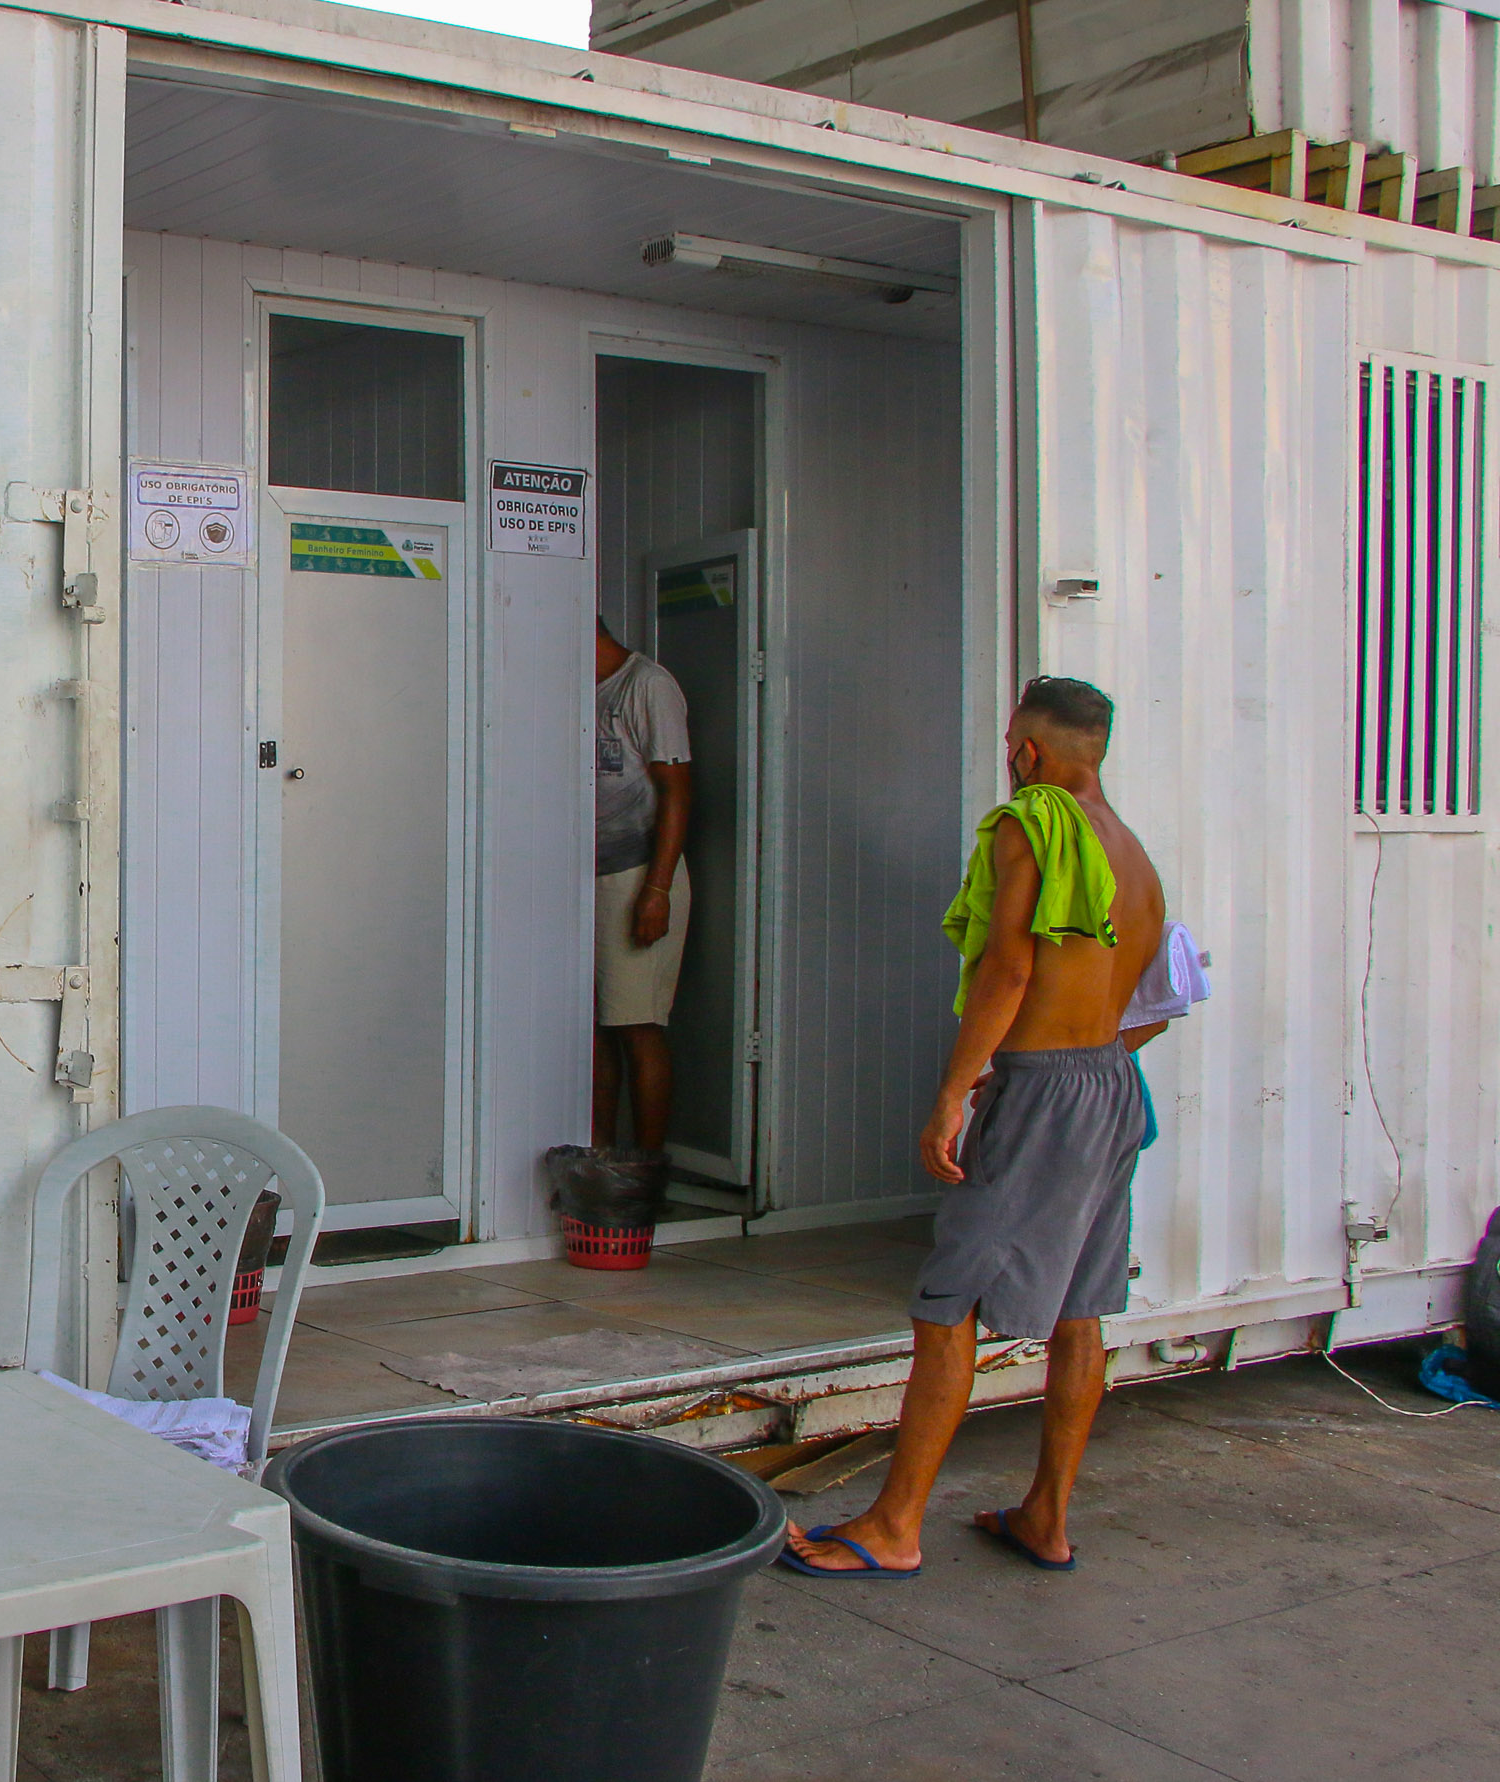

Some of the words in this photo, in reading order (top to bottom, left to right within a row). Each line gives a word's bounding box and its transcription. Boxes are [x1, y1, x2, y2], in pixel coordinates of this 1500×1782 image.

[140, 481, 162, 489] USO
[166, 482, 236, 494] OBRIGATÓRIO
[503, 472, 572, 493] ATENÇÃO
[169, 495, 183, 503] DE
[497, 500, 578, 517] OBRIGATÓRIO
[500, 517, 525, 530] USO
[529, 521, 544, 531] DE
[548, 521, 576, 534] EPI'S
[308, 544, 344, 555] Banheiro
[347, 547, 384, 557] Feminino
